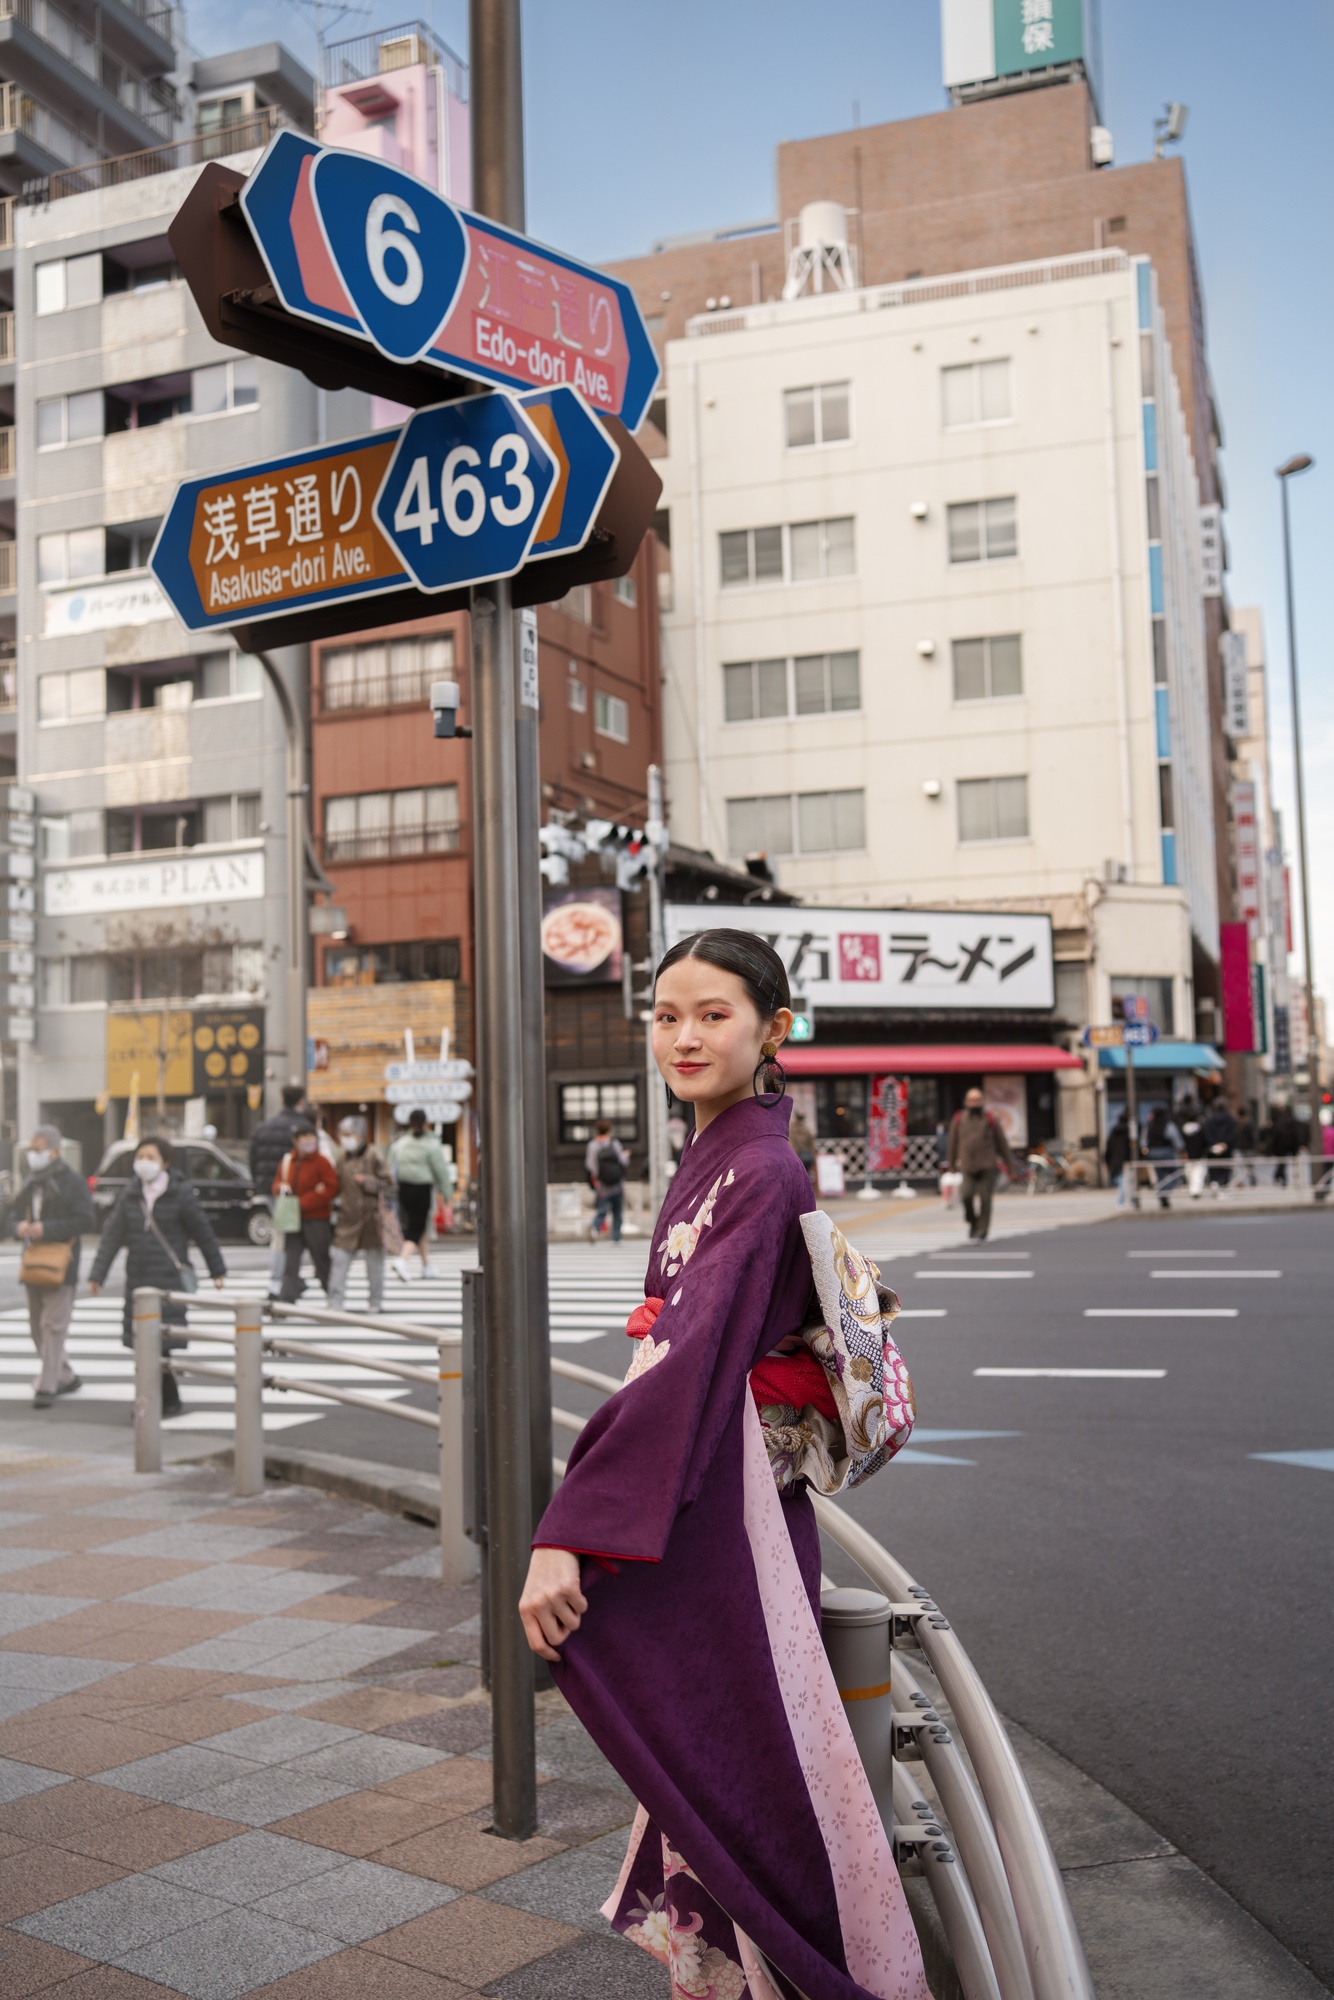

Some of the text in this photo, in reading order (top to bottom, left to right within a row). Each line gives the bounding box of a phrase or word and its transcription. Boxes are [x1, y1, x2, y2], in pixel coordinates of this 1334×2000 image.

[365, 193, 424, 306] 6
[476, 317, 612, 403] Edo-dori Ave.
[203, 465, 362, 566] 浅草通り
[393, 432, 535, 546] 463
[209, 542, 371, 608] Asakusa-dori Ave.
[160, 858, 249, 896] PLAN
